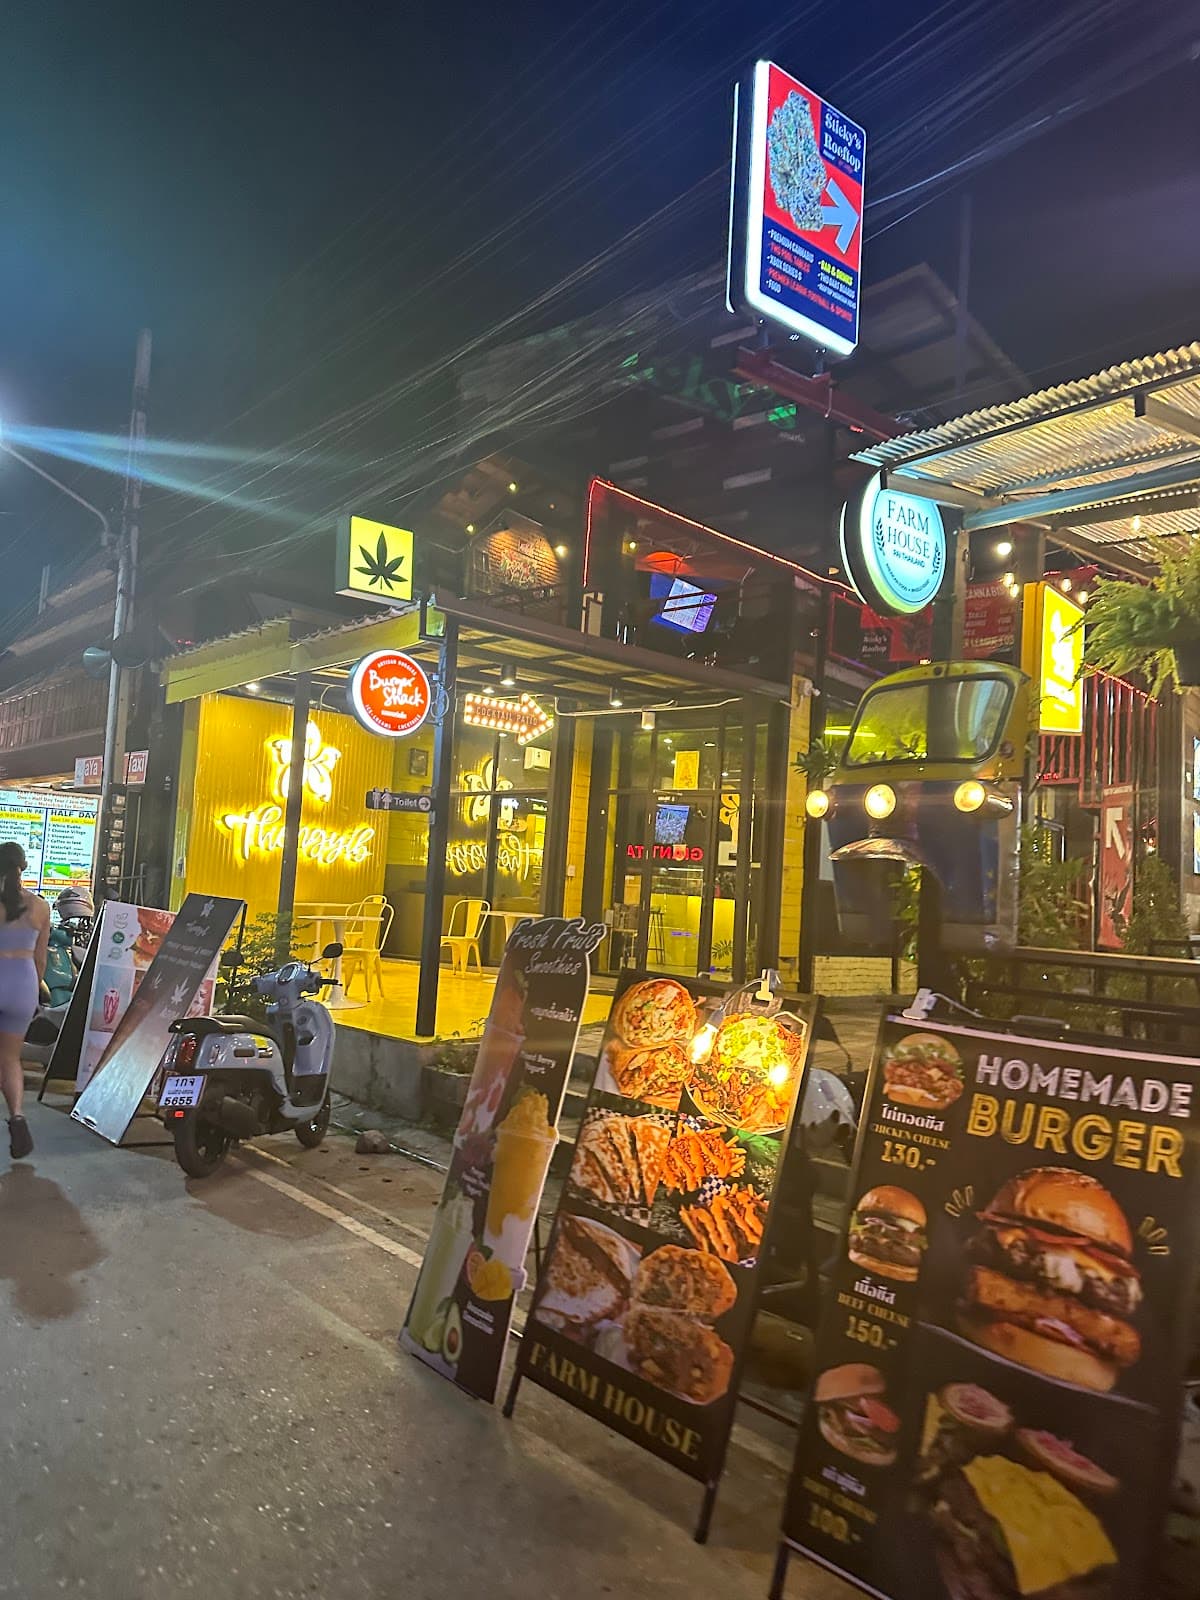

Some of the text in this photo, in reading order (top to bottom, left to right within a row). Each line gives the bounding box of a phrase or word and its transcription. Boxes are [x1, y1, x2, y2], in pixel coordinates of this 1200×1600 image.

[825, 113, 861, 150] Sticky's
[824, 132, 861, 172] Rooftop
[887, 499, 929, 535] FARM
[887, 526, 931, 559] HOUSE
[368, 669, 416, 692] Burger
[383, 686, 425, 707] Shack
[476, 707, 538, 726] COCKTAIL PATIO
[50, 809, 74, 817] HALF
[78, 811, 97, 819] DAY
[393, 797, 418, 808] Toilet
[506, 921, 603, 949] Fresh Fruit
[524, 951, 582, 976] Smoothies
[975, 1054, 1193, 1118] HOMEMADE
[164, 1096, 193, 1106] 5655
[881, 1103, 945, 1132] ไก่ทอดชีส
[912, 1133, 952, 1150] CHEESE
[966, 1093, 1184, 1178] BURGER
[880, 1140, 936, 1171] 130.-
[846, 1315, 898, 1351] 150.-
[529, 1342, 703, 1462] FARM HOUSE
